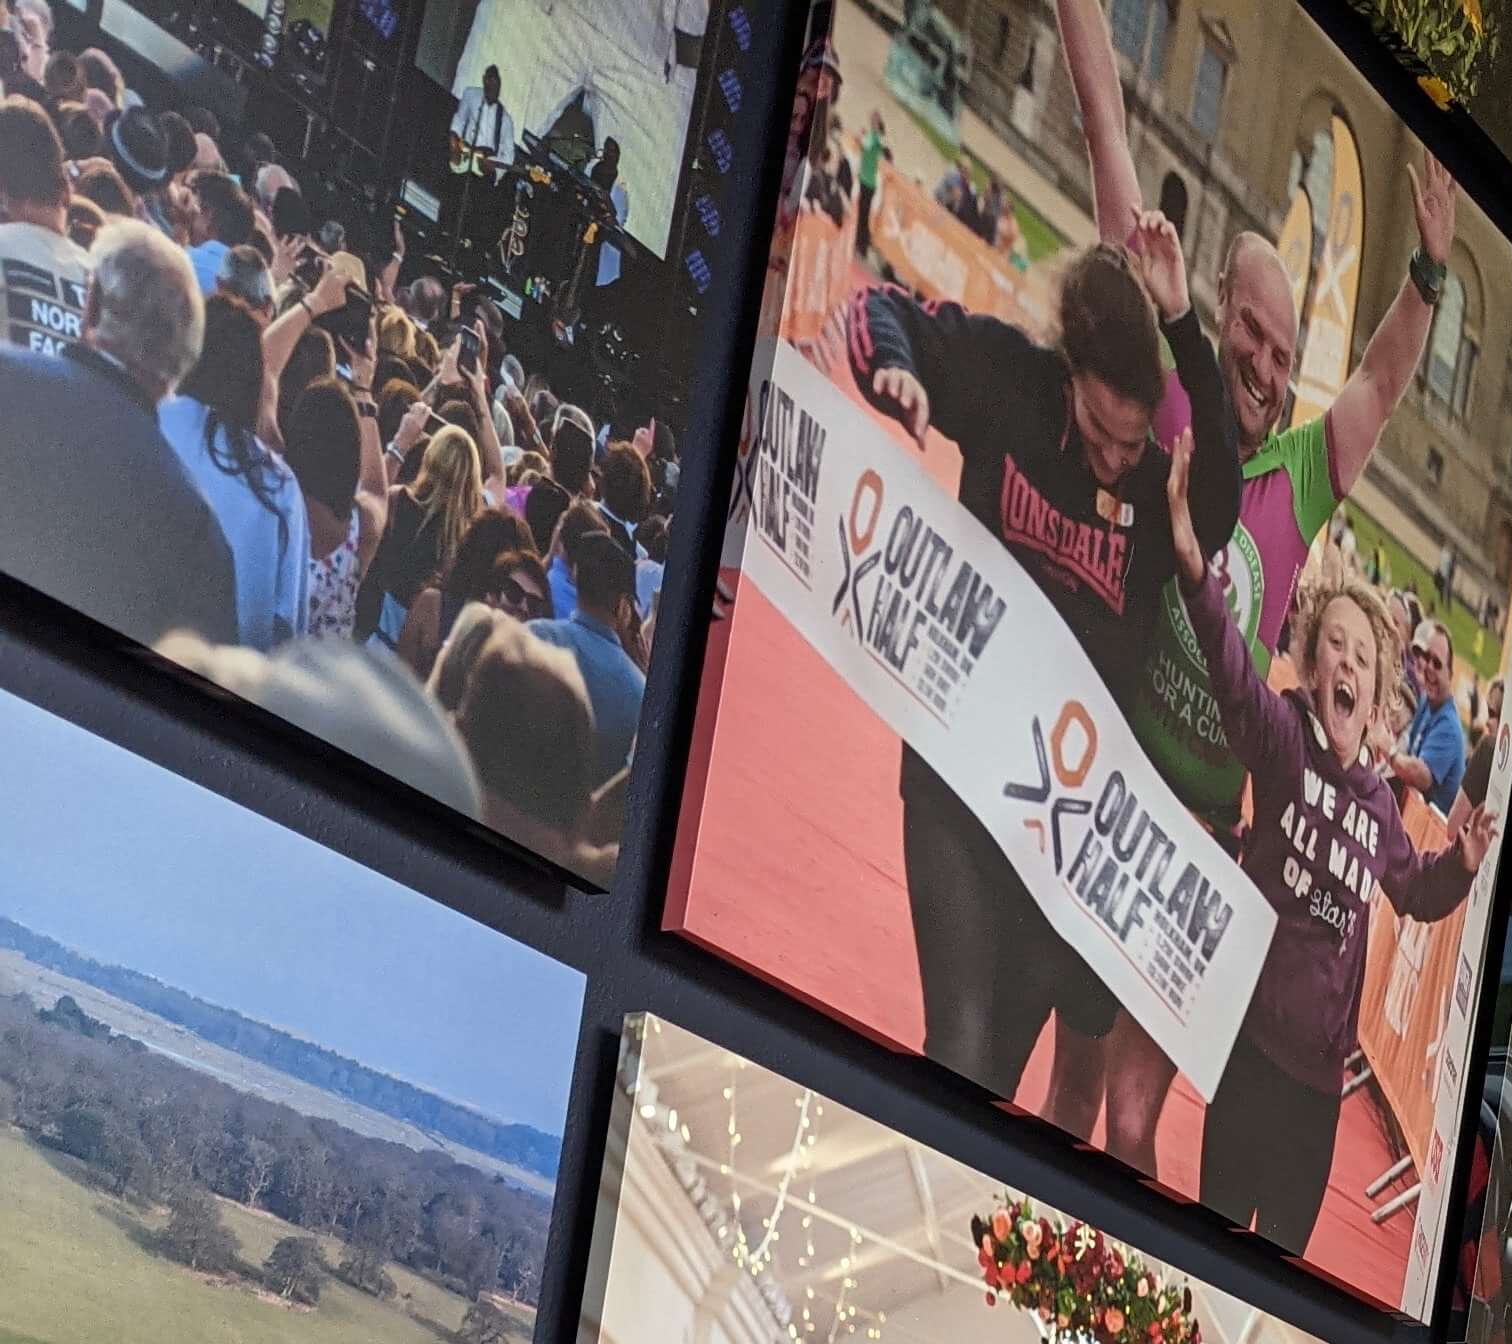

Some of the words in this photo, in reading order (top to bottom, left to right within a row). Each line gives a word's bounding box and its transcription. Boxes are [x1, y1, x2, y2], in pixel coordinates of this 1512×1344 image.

[884, 505, 1007, 660] OUTLAW
[1001, 453, 1126, 616] LONSDALE
[866, 573, 927, 673] HALF
[1179, 703, 1192, 727] A
[1280, 801, 1318, 862] ALL
[1304, 768, 1336, 820] WE
[1342, 801, 1379, 857] ARE
[1067, 828, 1152, 944] HALF
[1095, 770, 1234, 962] OUTLAW
[1283, 856, 1312, 898] OF
